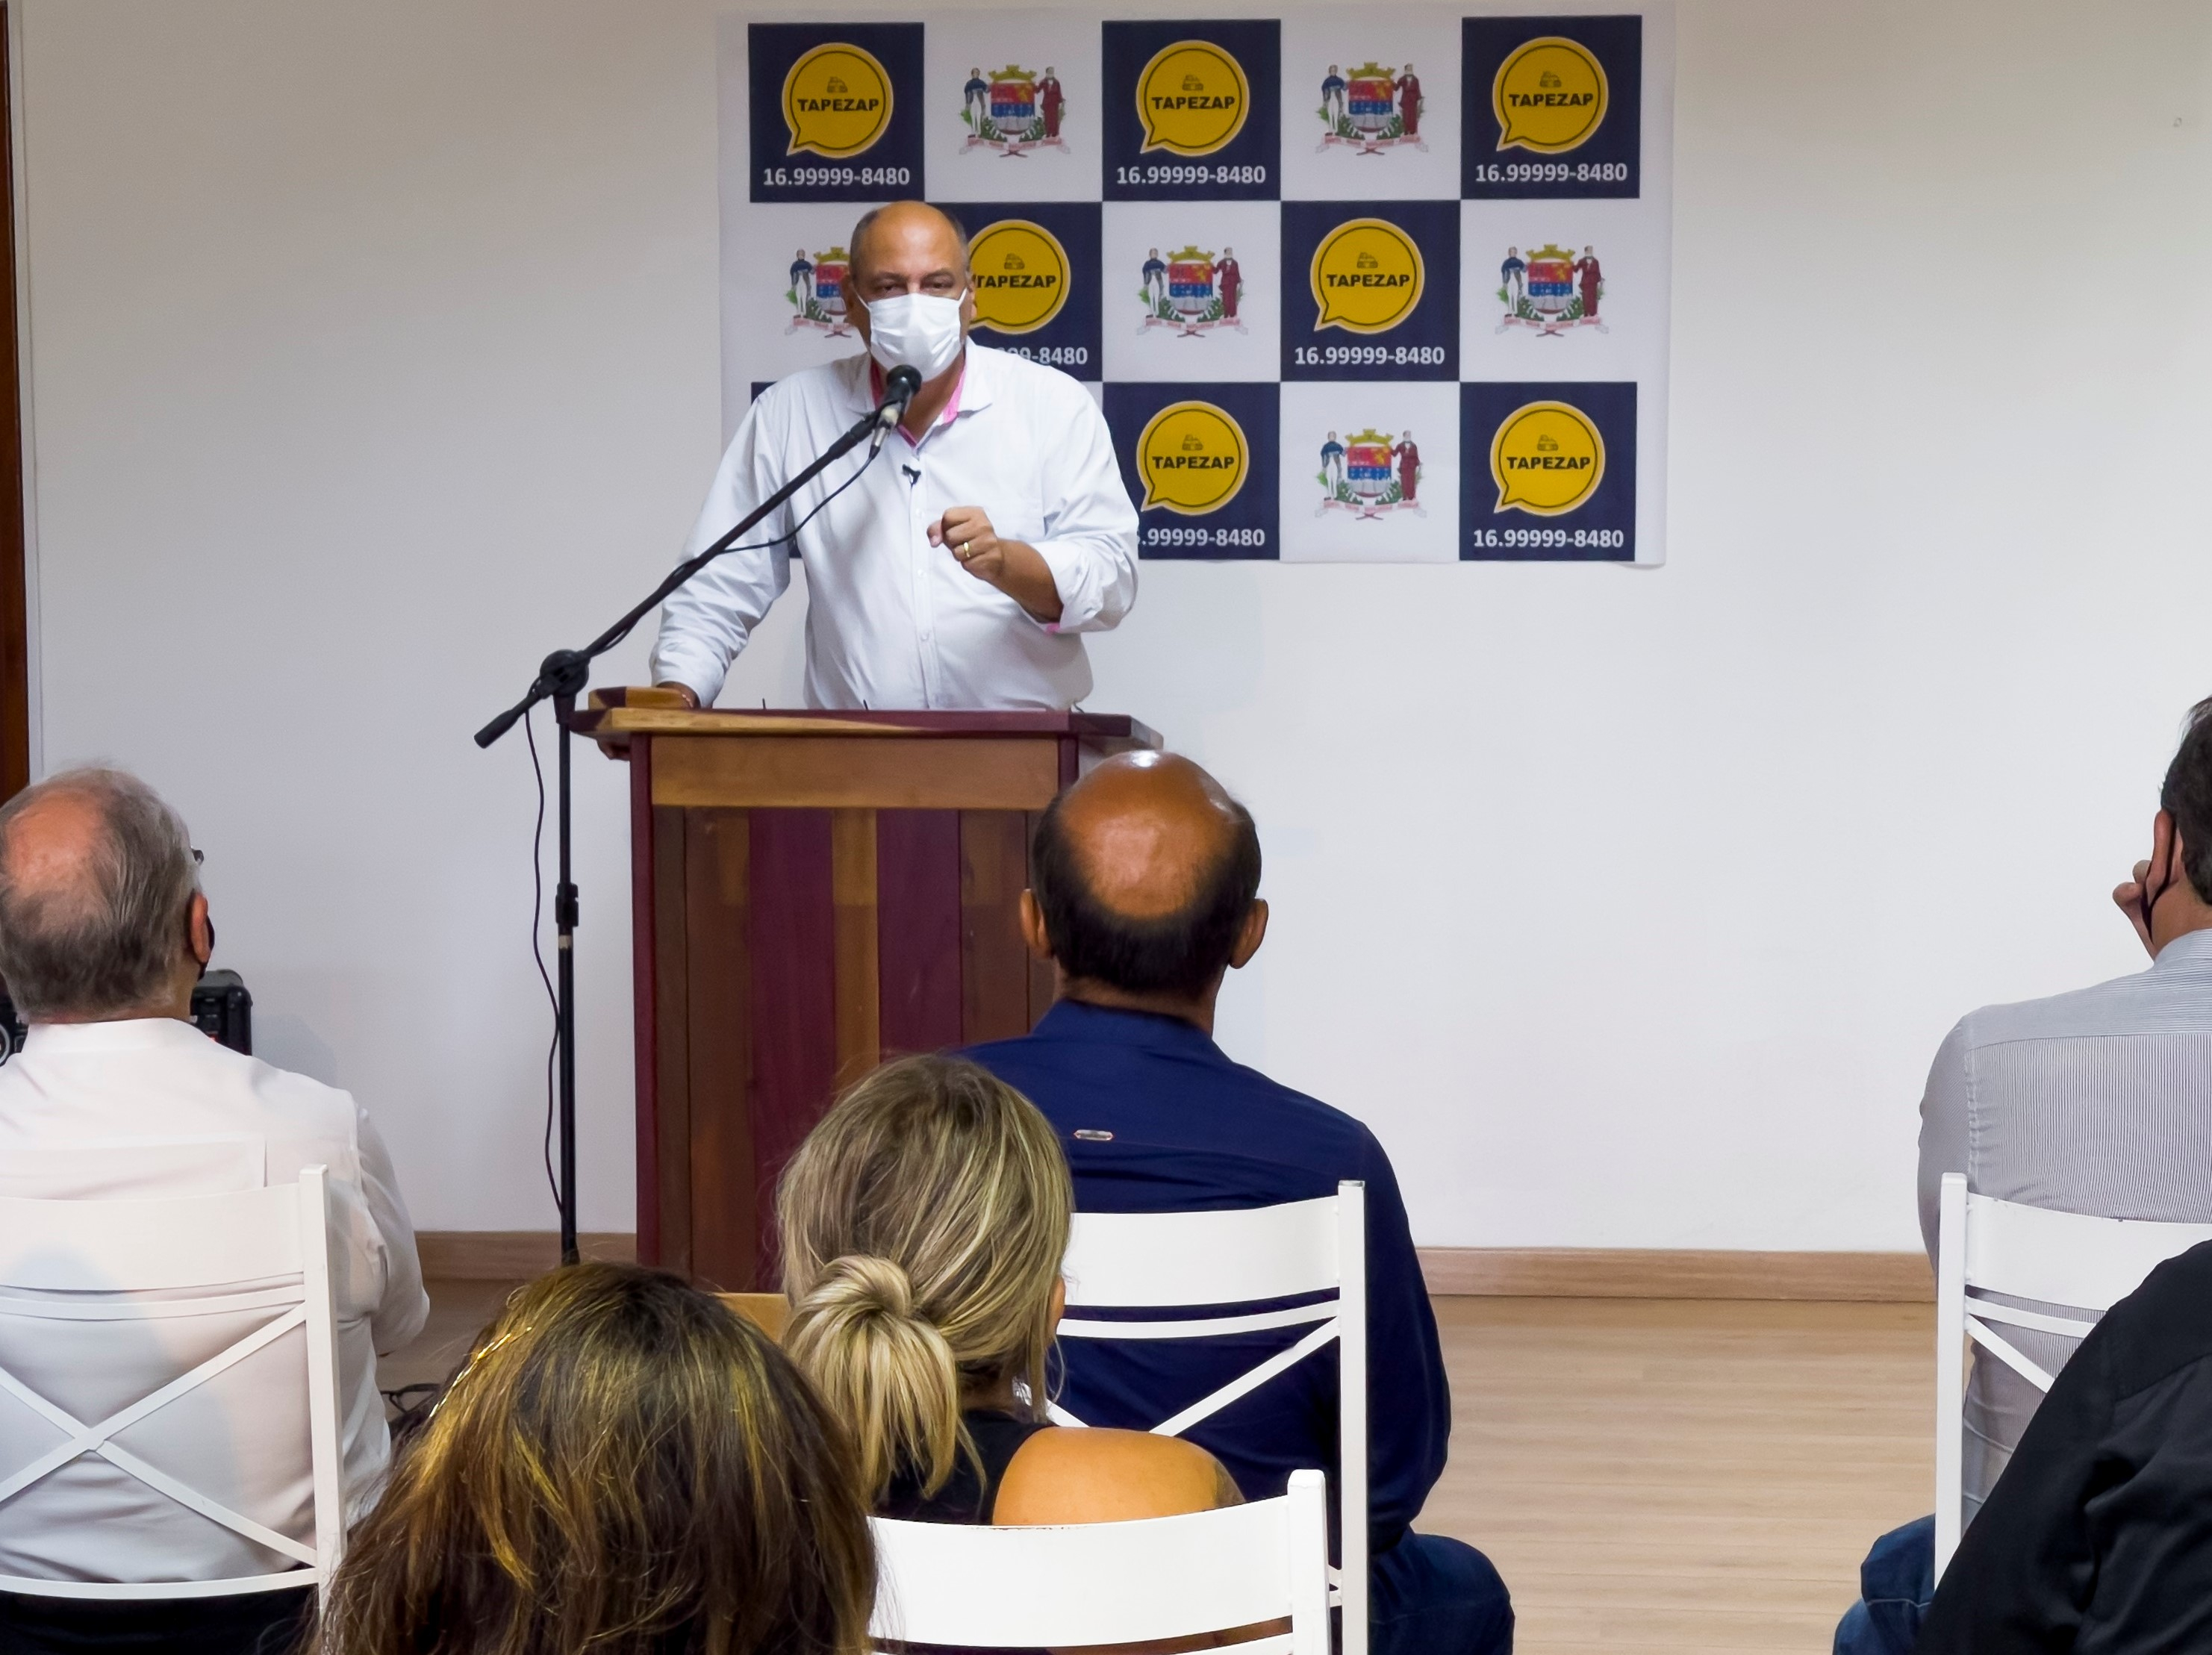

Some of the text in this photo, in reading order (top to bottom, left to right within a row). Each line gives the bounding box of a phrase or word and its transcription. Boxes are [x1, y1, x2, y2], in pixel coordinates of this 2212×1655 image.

[797, 99, 879, 112] TAPEZAP
[1151, 96, 1236, 110] TAPEZAP
[1508, 93, 1594, 107] TAPEZAP
[763, 167, 910, 186] 16.99999-8480
[1117, 166, 1266, 184] 16.99999-8480
[1476, 163, 1627, 182] 16.99999-8480
[973, 274, 1056, 289] TAPEZAP
[1326, 273, 1410, 288] TAPEZAP
[1295, 346, 1445, 365] 16.99999-8480
[1152, 455, 1236, 470] TAPEZAP
[1506, 455, 1591, 470] TAPEZAP
[1137, 528, 1265, 546] .99999-8480
[1474, 529, 1624, 548] 16.99999-8480
